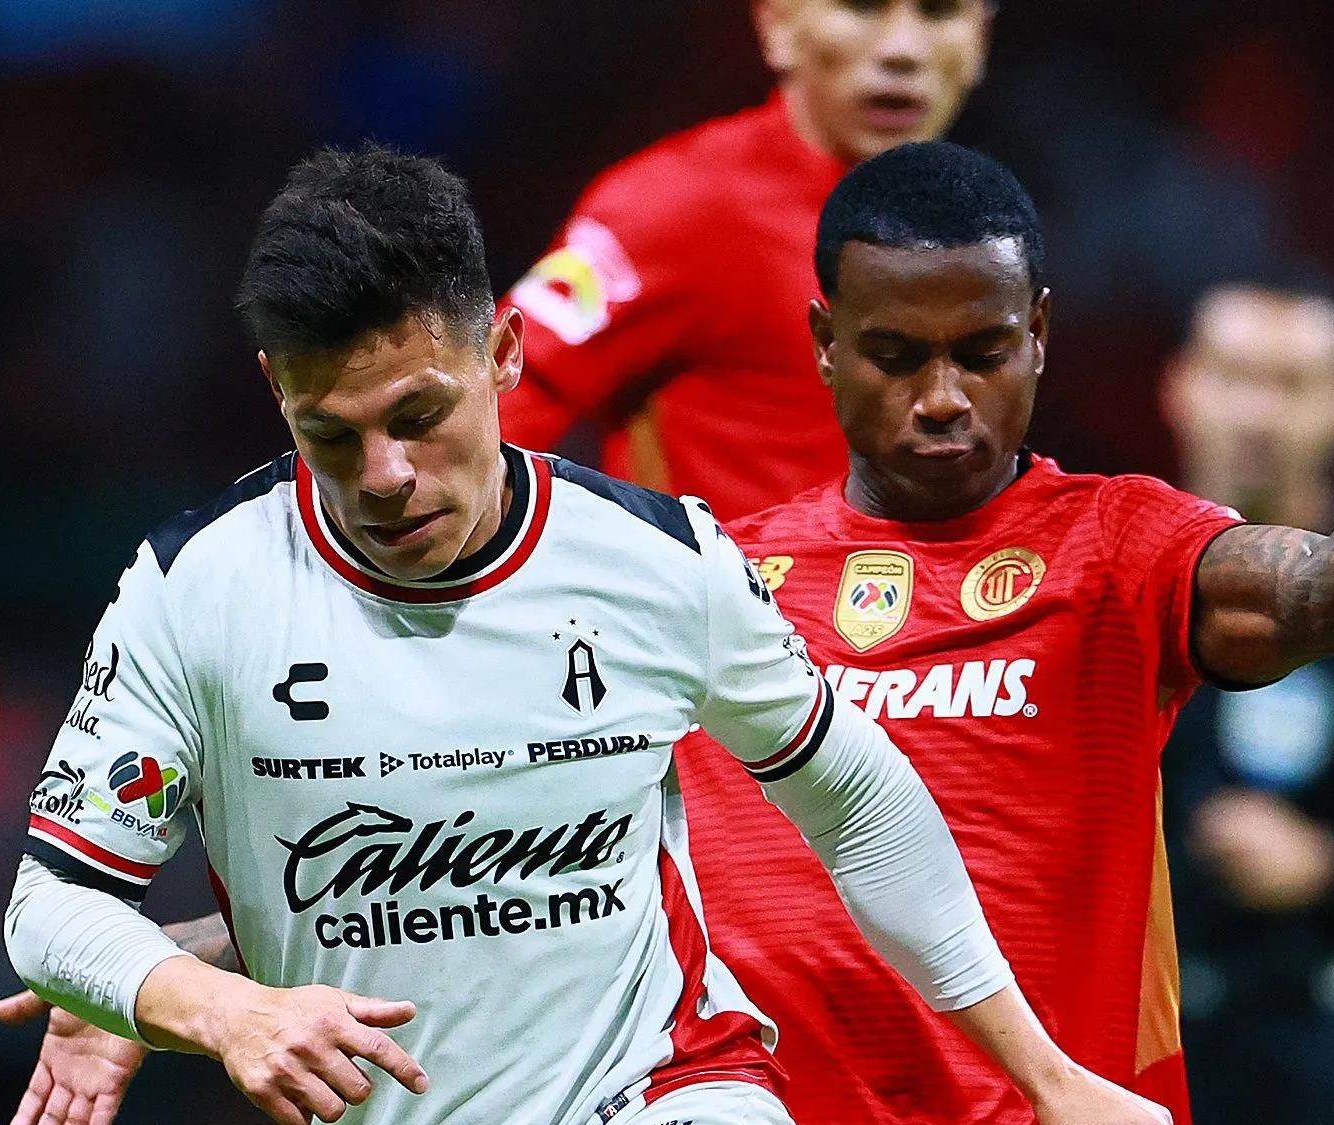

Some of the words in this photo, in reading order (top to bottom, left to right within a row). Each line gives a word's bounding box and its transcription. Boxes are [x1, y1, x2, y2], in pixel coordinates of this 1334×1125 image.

[747, 556, 795, 591] B
[408, 748, 505, 771] Totalplay
[527, 734, 650, 763] PERDURA
[252, 756, 366, 780] SURTEK
[110, 807, 157, 838] BBVA
[273, 801, 634, 915] Caliente
[315, 879, 626, 949] caliente.mx
